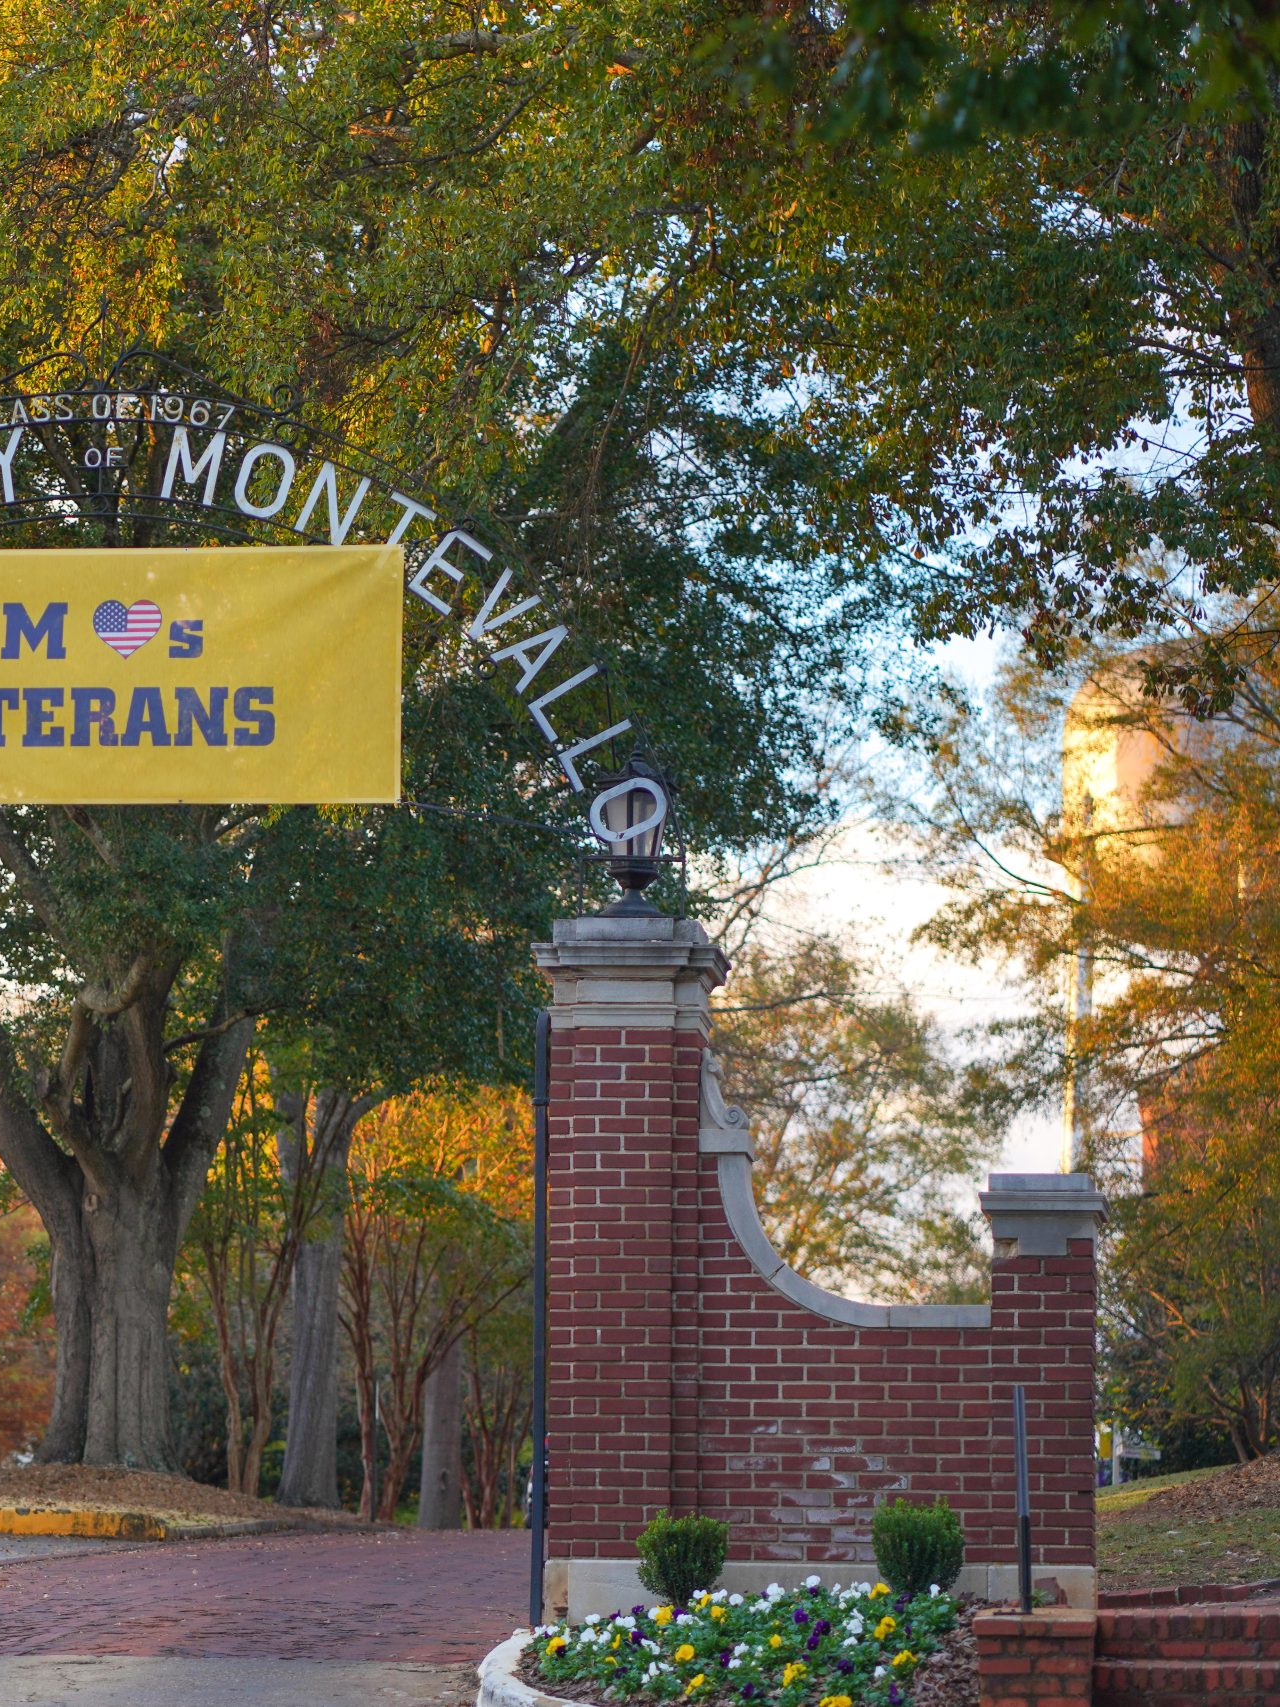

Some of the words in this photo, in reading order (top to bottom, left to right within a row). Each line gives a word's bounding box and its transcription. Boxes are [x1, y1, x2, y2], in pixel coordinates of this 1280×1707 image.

[92, 393, 138, 419] OF
[150, 393, 236, 430] 1967
[84, 447, 124, 467] OF
[160, 425, 667, 842] MONTEVALLO
